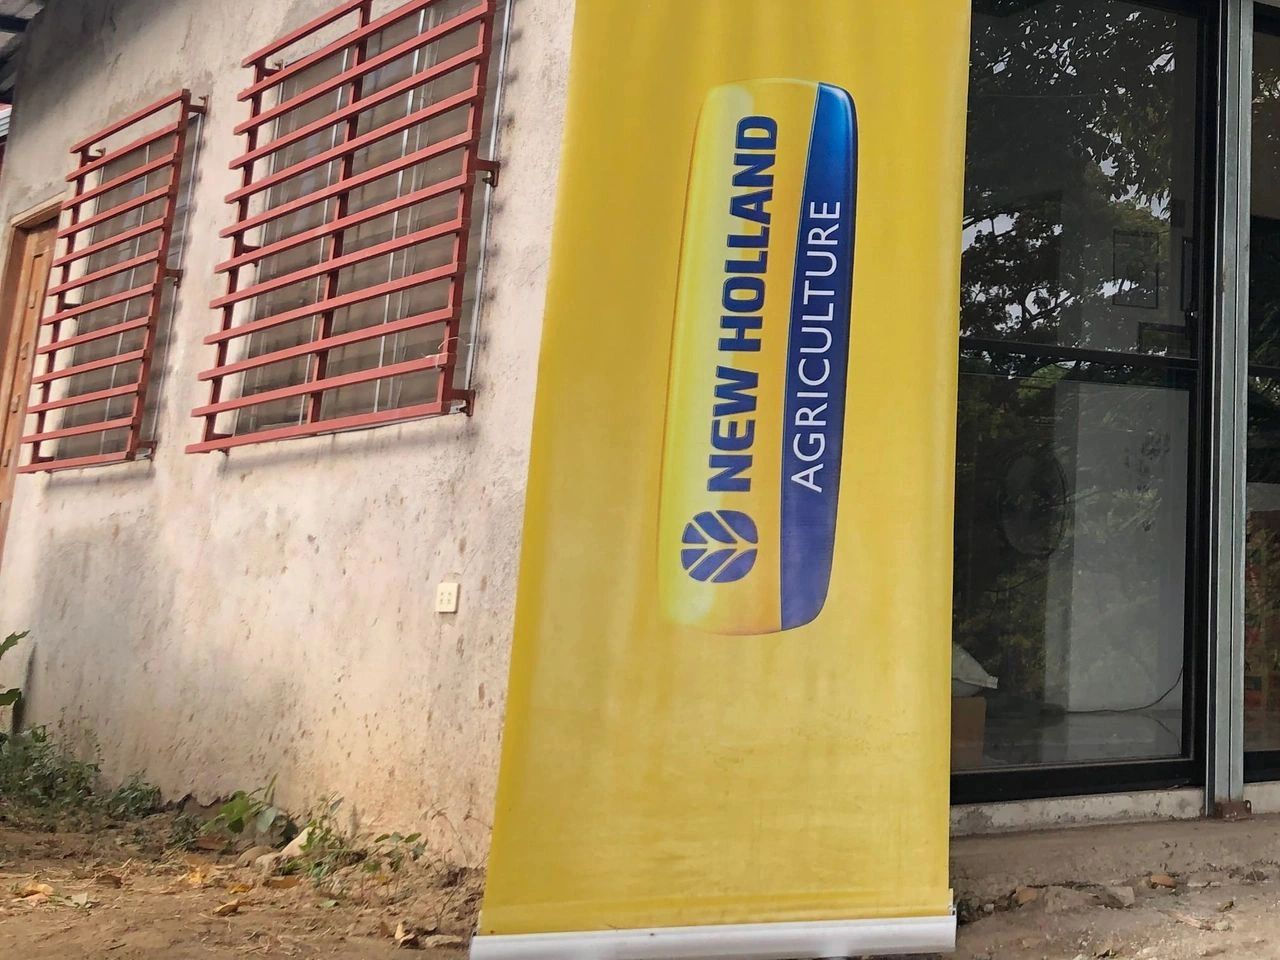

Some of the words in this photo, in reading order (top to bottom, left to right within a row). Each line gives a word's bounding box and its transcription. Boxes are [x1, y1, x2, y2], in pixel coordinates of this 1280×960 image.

[715, 115, 779, 352] HOLLAND
[790, 200, 841, 493] AGRICULTURE
[707, 365, 760, 492] NEW
